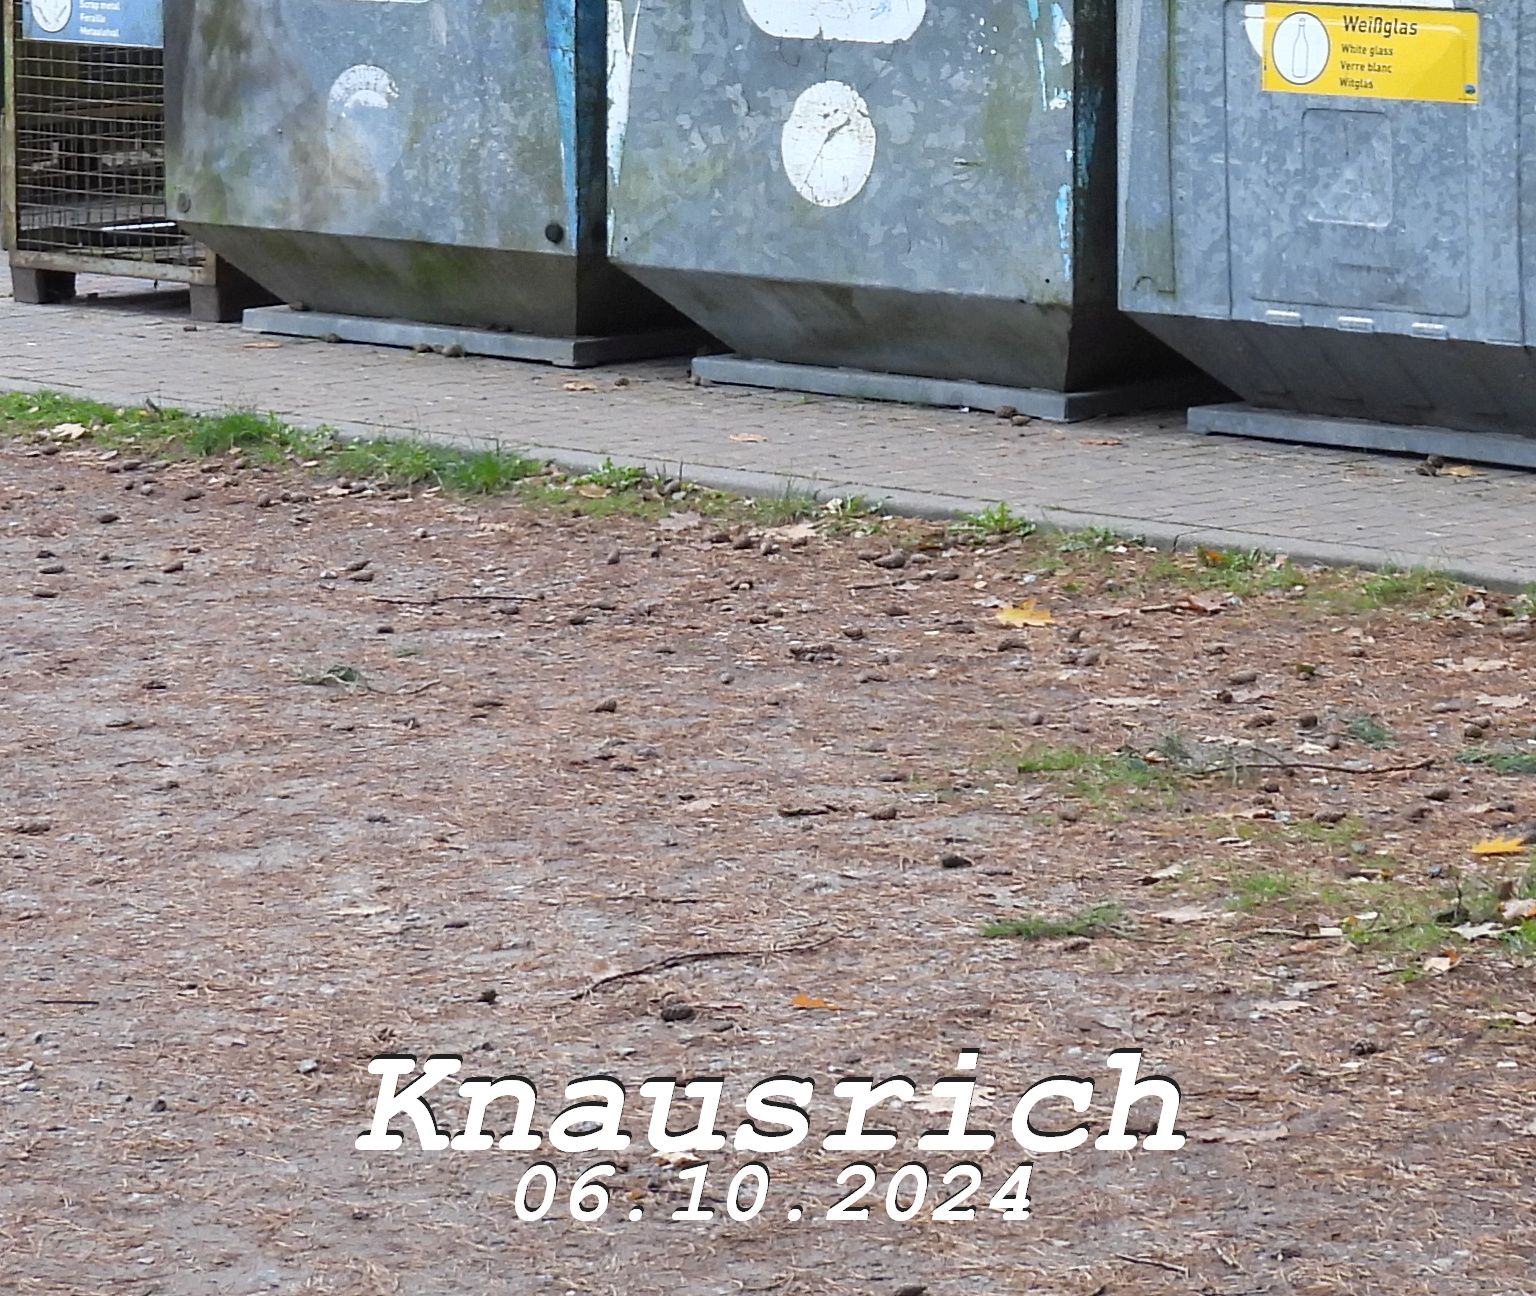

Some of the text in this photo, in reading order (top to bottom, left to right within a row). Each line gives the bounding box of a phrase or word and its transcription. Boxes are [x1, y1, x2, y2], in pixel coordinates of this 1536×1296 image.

[1343, 15, 1418, 38] Weißglas
[1341, 43, 1394, 56] White glass
[1340, 60, 1393, 73] Verre blanc
[1339, 77, 1374, 90] Witglas
